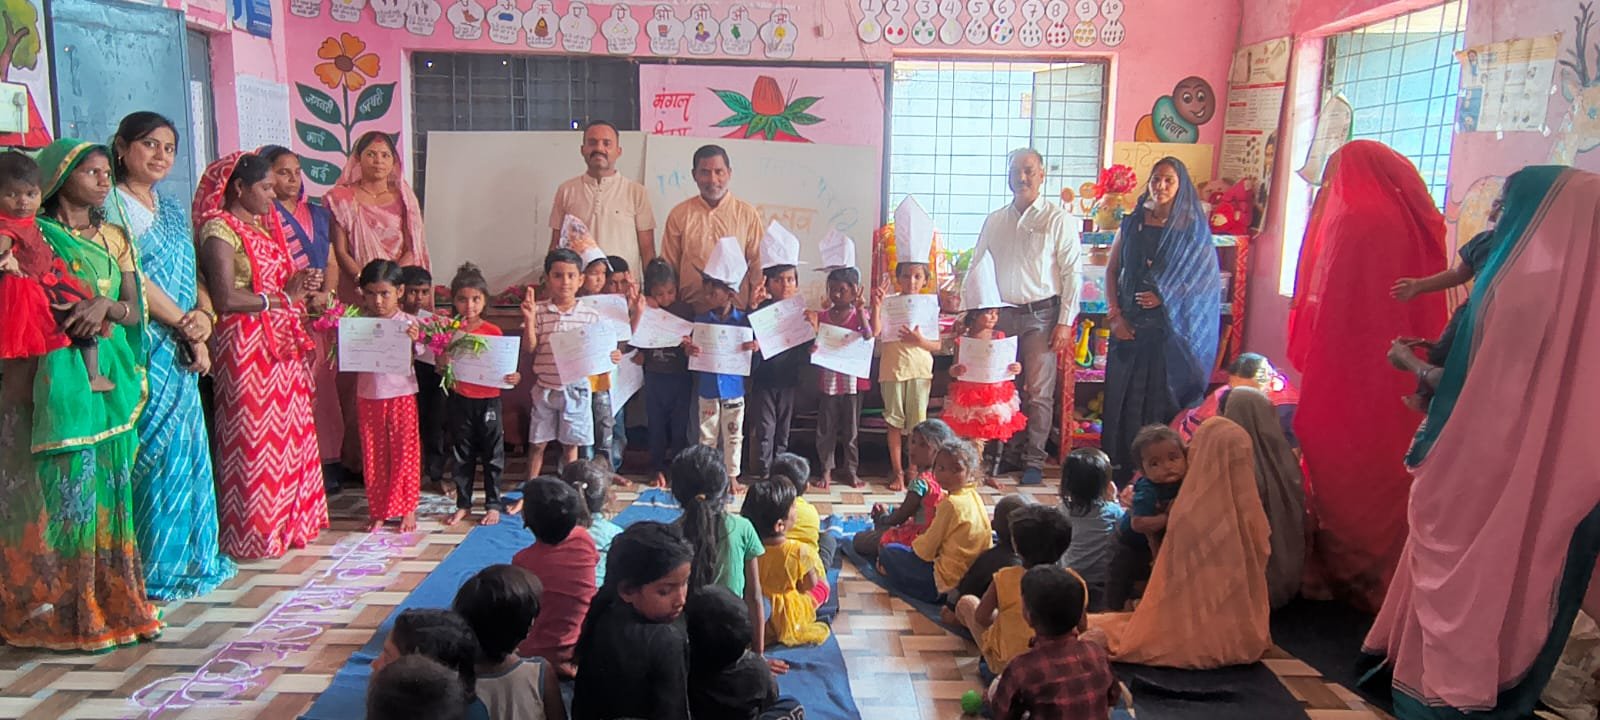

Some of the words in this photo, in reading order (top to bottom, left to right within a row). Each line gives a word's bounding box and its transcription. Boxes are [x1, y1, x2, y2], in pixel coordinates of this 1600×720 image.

[864, 0, 874, 12] 1
[892, 0, 902, 12] 2
[920, 1, 931, 14] 3
[944, 1, 956, 14] 4
[972, 2, 984, 14] 5
[998, 4, 1007, 14] 6
[1028, 4, 1038, 18] 7
[1052, 4, 1061, 17] 8
[1081, 2, 1091, 14] 9
[653, 87, 696, 122] मंगल
[1160, 114, 1188, 138] रविवार
